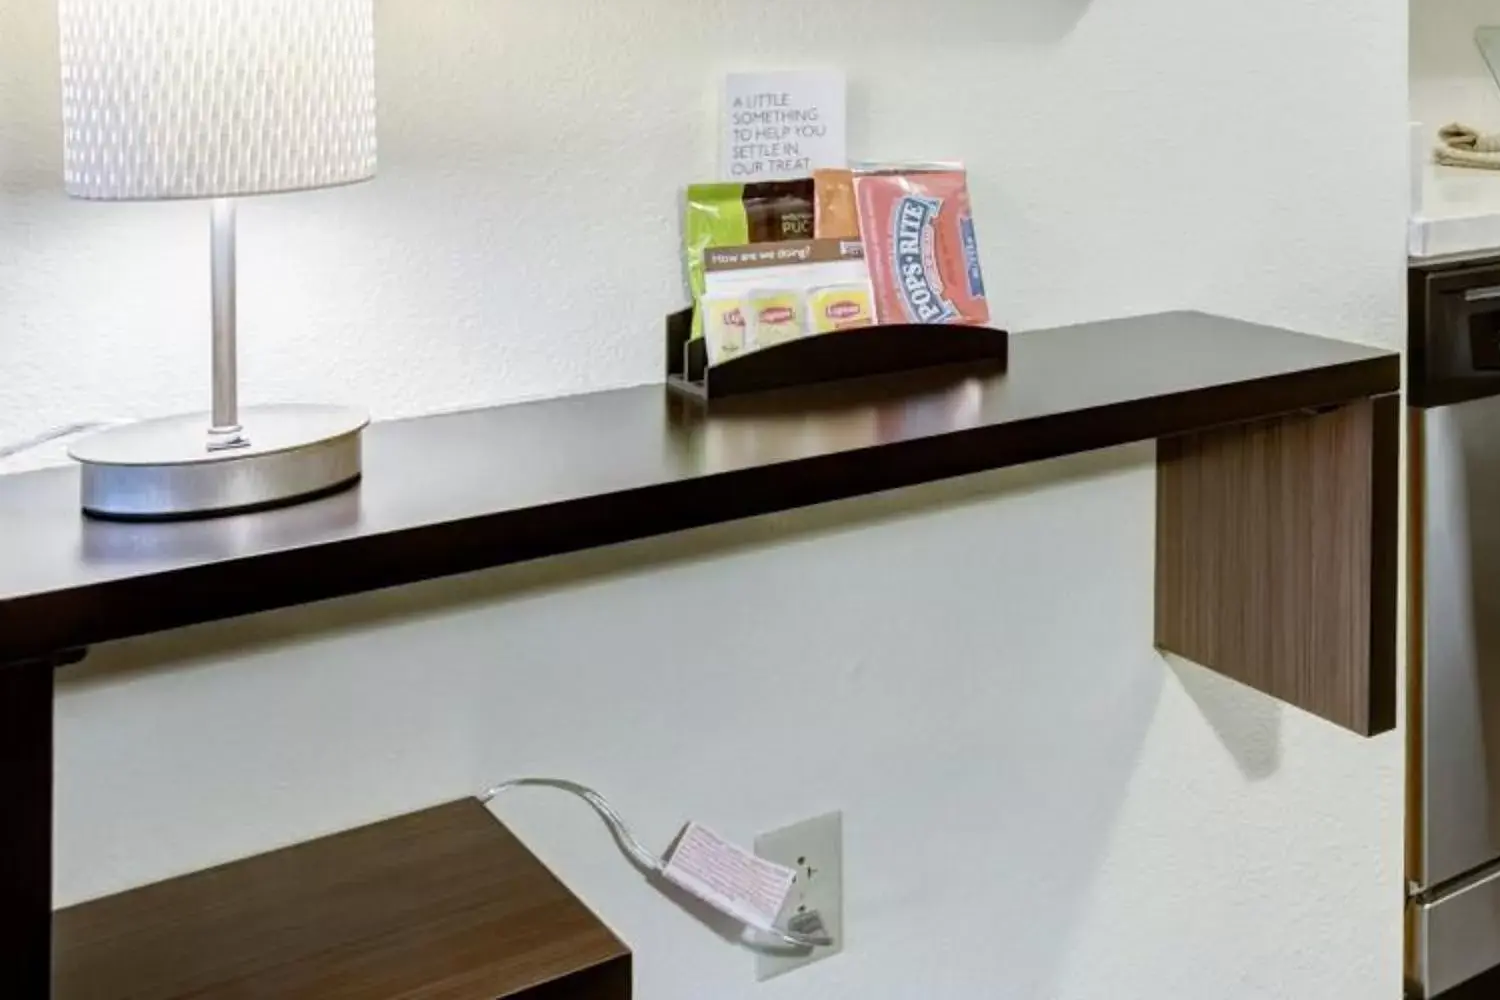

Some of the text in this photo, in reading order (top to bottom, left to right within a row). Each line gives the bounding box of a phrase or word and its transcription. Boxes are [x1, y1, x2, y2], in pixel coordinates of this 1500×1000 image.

[733, 93, 791, 108] A LITTLE
[732, 107, 818, 125] SOMETHING
[733, 124, 827, 142] TO HELP YOU
[732, 143, 780, 159] SETTLE
[731, 157, 811, 175] OUR TREAT
[712, 253, 737, 264] How
[777, 246, 811, 260] doing?
